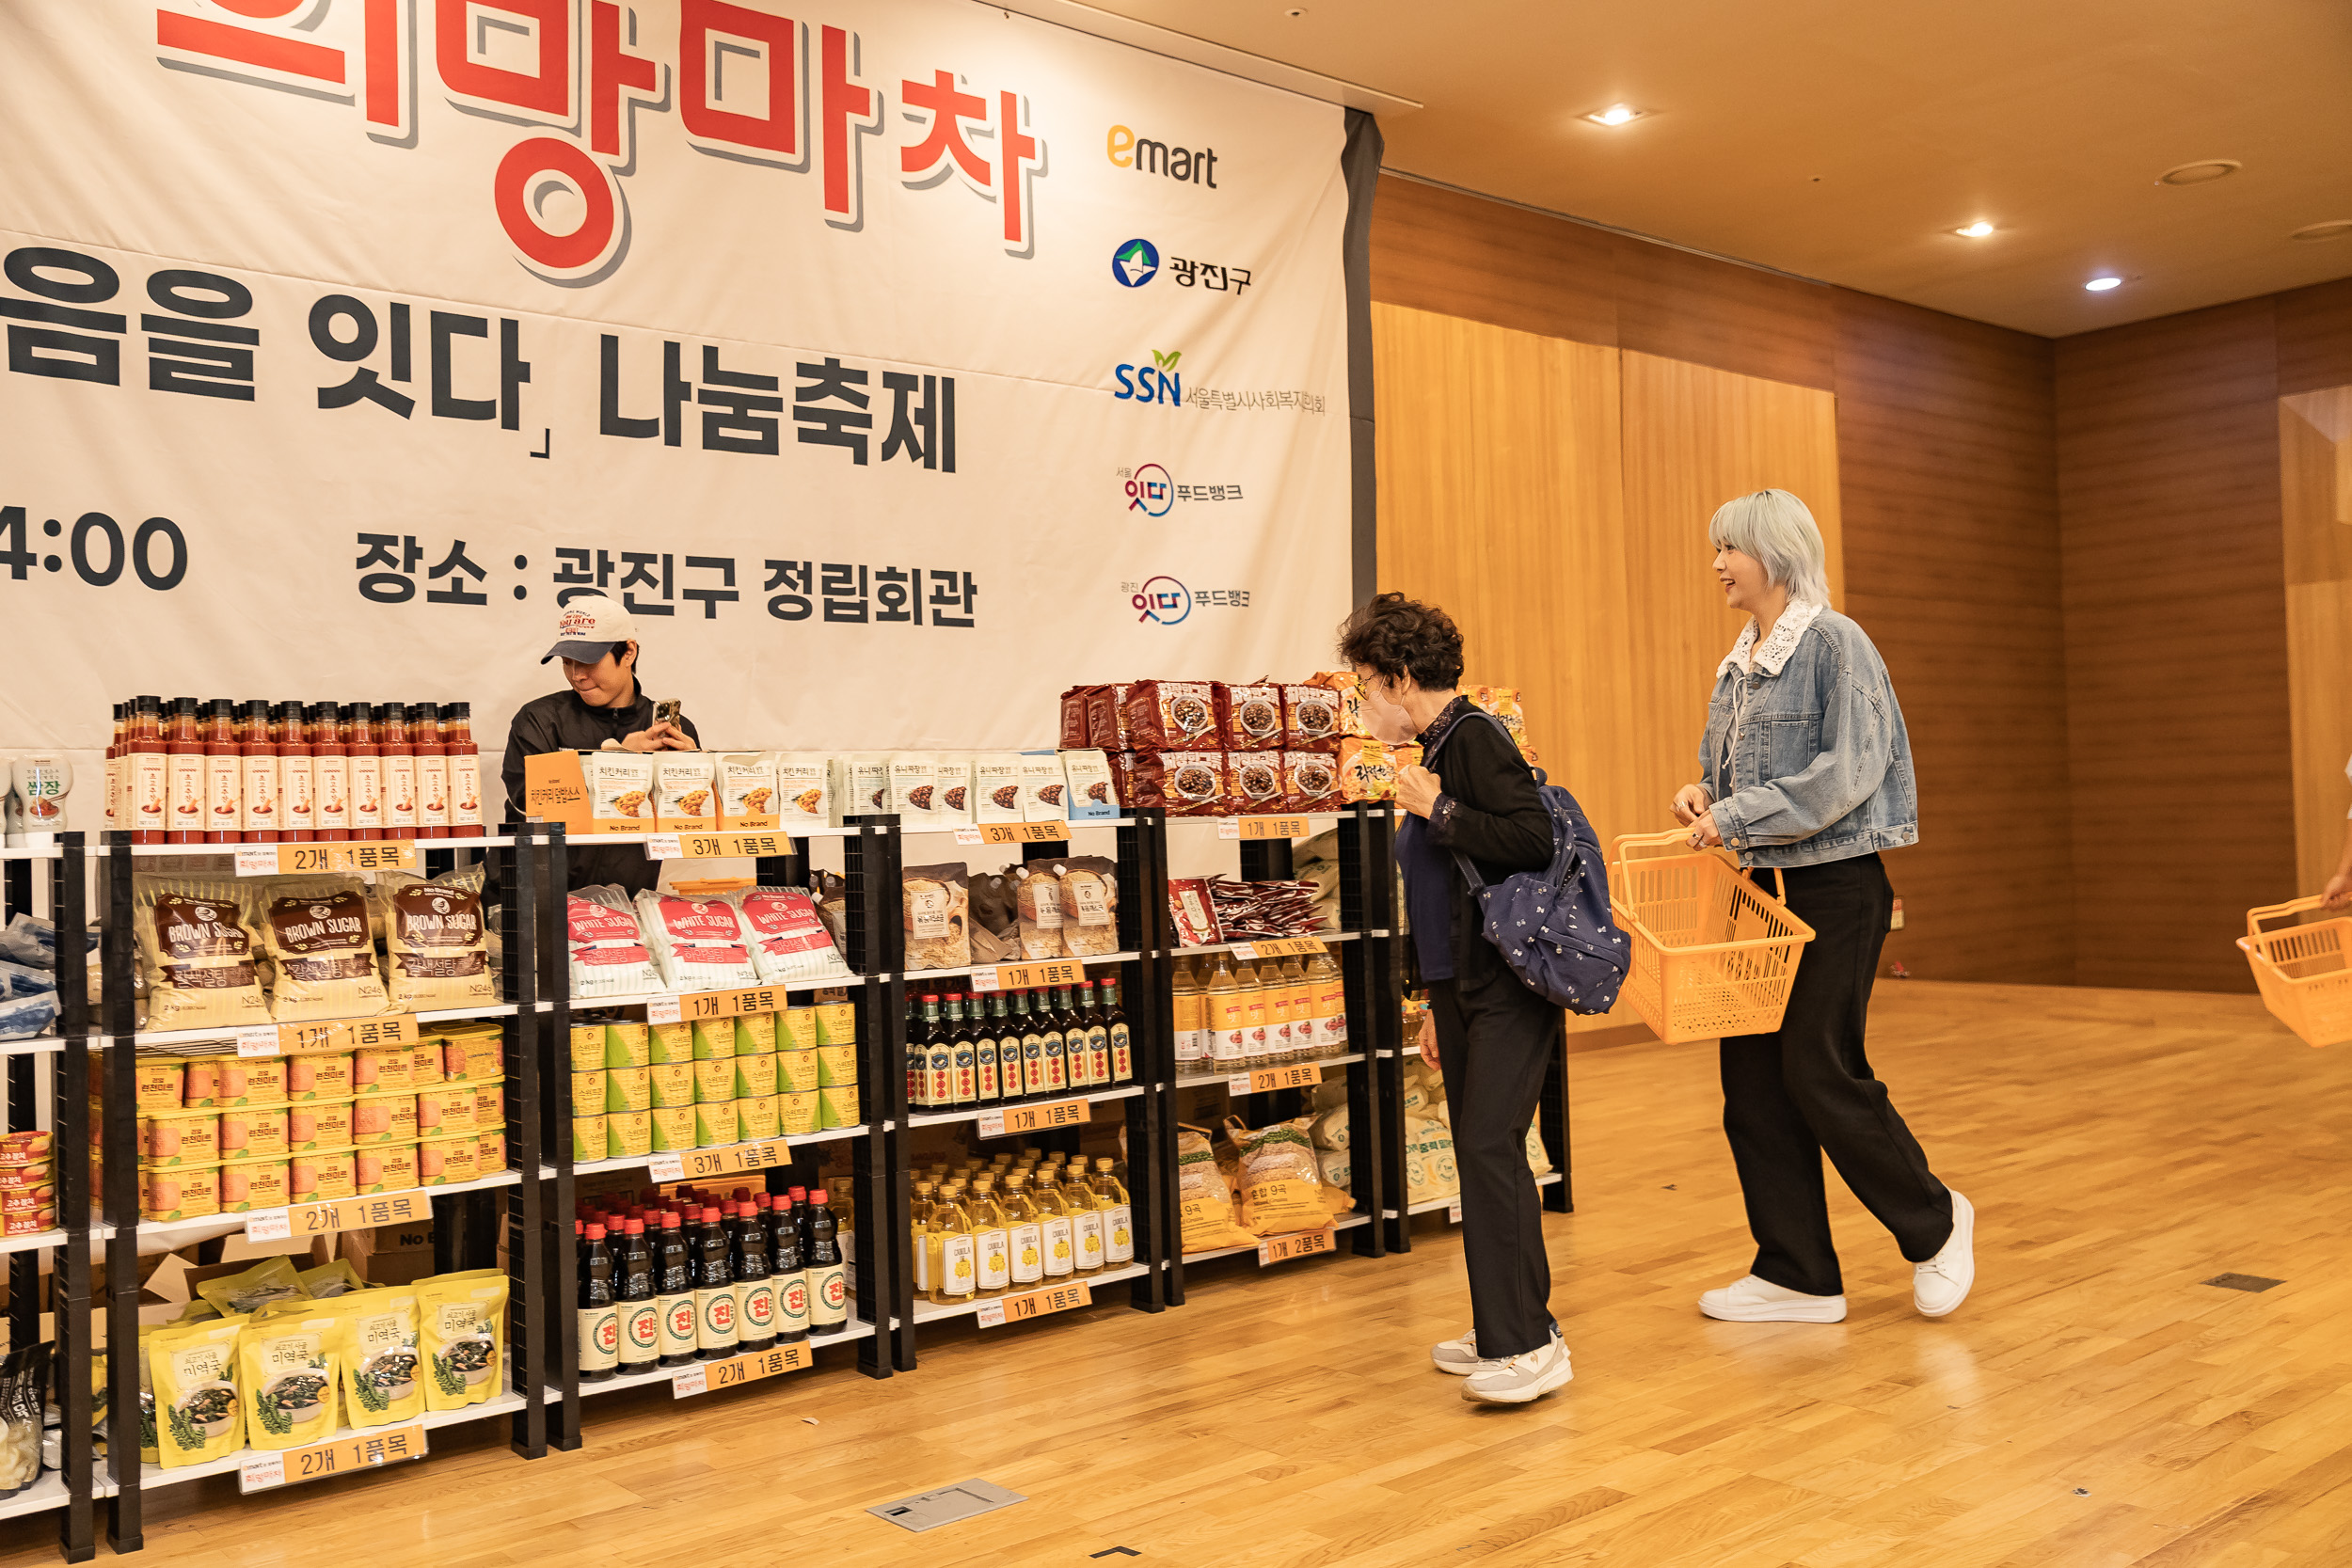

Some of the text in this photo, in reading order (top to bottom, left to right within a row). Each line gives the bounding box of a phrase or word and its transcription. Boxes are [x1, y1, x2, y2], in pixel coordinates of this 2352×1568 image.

[1107, 124, 1218, 189] emart
[1169, 256, 1251, 295] 광진구
[1114, 363, 1181, 406] SSN
[599, 334, 956, 473] 나눔축제
[1116, 467, 1132, 479] 서울
[1125, 480, 1243, 511] 잇다 푸드뱅크
[356, 532, 487, 606] 장소
[553, 546, 739, 620] 광진구
[764, 558, 977, 628] 정립회관
[1120, 581, 1138, 594] 광진
[1132, 593, 1181, 624] 잇다
[663, 768, 692, 777] 치킨커리
[990, 825, 1060, 841] 3개 1품목
[1248, 820, 1300, 836] 1개 1품목
[693, 838, 722, 856] 3개
[734, 837, 777, 855] 1품목
[294, 847, 400, 870] 2개 1품목
[406, 913, 478, 931] BROWN SUGAR
[571, 920, 605, 932] WHITE
[672, 914, 736, 930] WHITE SUGAR
[756, 909, 816, 925] WHITE SUGAR
[168, 922, 246, 943] BROWN SUGAR
[284, 917, 363, 943] BROWN SUGAR
[1261, 940, 1318, 956] 2개 1품목
[1009, 965, 1073, 986] 1개 1품목
[693, 997, 719, 1016] 1개
[732, 991, 773, 1012] 1품목
[296, 1021, 401, 1049] 1개 1품목
[1258, 1068, 1312, 1089] 2개 1품목
[1014, 1104, 1080, 1129] 1개 1품목
[694, 1146, 778, 1174] 3개 1품목
[1270, 1184, 1287, 1196] 9곡
[306, 1198, 412, 1230] 2개 1품목
[1272, 1234, 1325, 1259] 1개 2품목
[787, 1289, 804, 1309] 진
[829, 1280, 843, 1302] 진
[753, 1296, 770, 1318] 진
[1014, 1288, 1080, 1317] 1개 1품목
[444, 1317, 477, 1332] 미역국
[675, 1309, 691, 1331] 진
[713, 1304, 731, 1325] 진
[368, 1327, 400, 1344] 미역국
[602, 1323, 616, 1346] 진
[637, 1317, 654, 1339] 진
[184, 1359, 222, 1376] 미역국
[272, 1350, 310, 1365] 미역국
[718, 1349, 799, 1385] 2개 1품목
[300, 1434, 407, 1475] 2개 1품목
